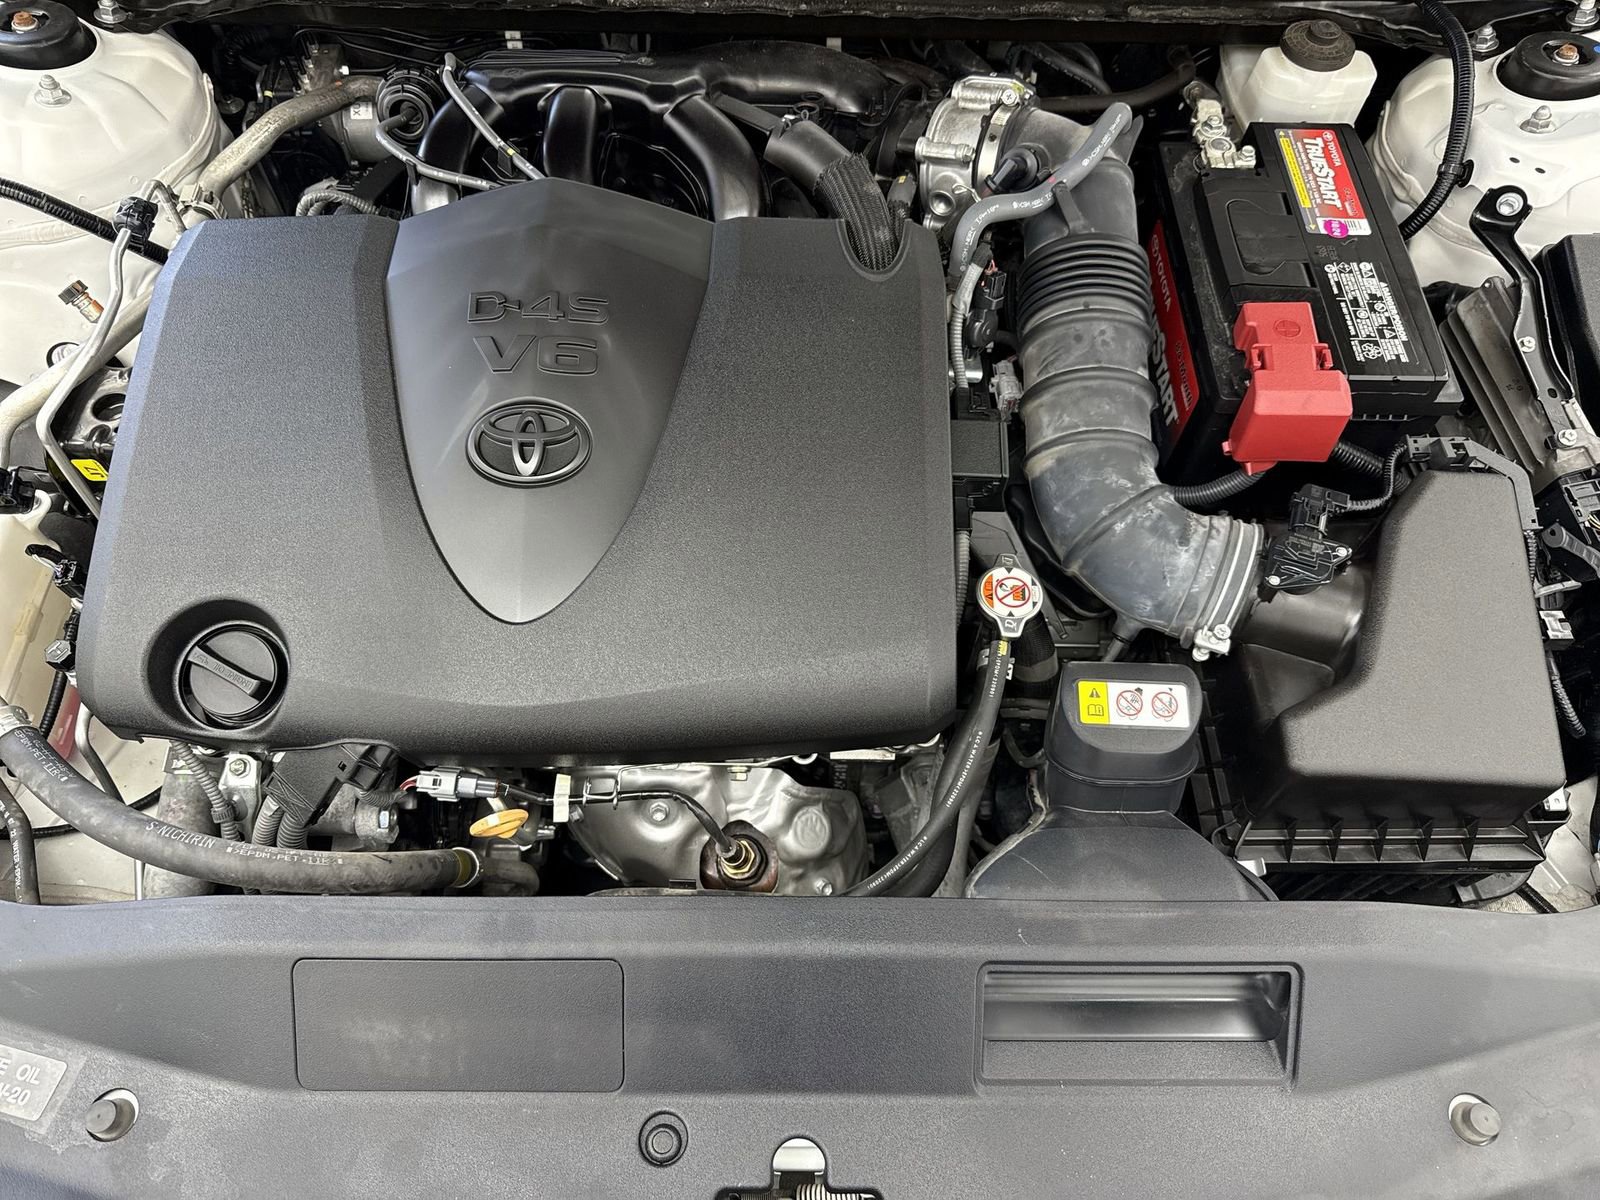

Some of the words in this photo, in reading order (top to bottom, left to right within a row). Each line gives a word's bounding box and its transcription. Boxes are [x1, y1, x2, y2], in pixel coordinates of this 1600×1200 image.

[1327, 141, 1342, 167] TOYOTA
[1156, 253, 1171, 312] TOYOTA
[467, 291, 608, 325] D-4S
[473, 335, 598, 376] V6
[213, 663, 224, 674] OIL
[16, 1064, 41, 1085] OIL
